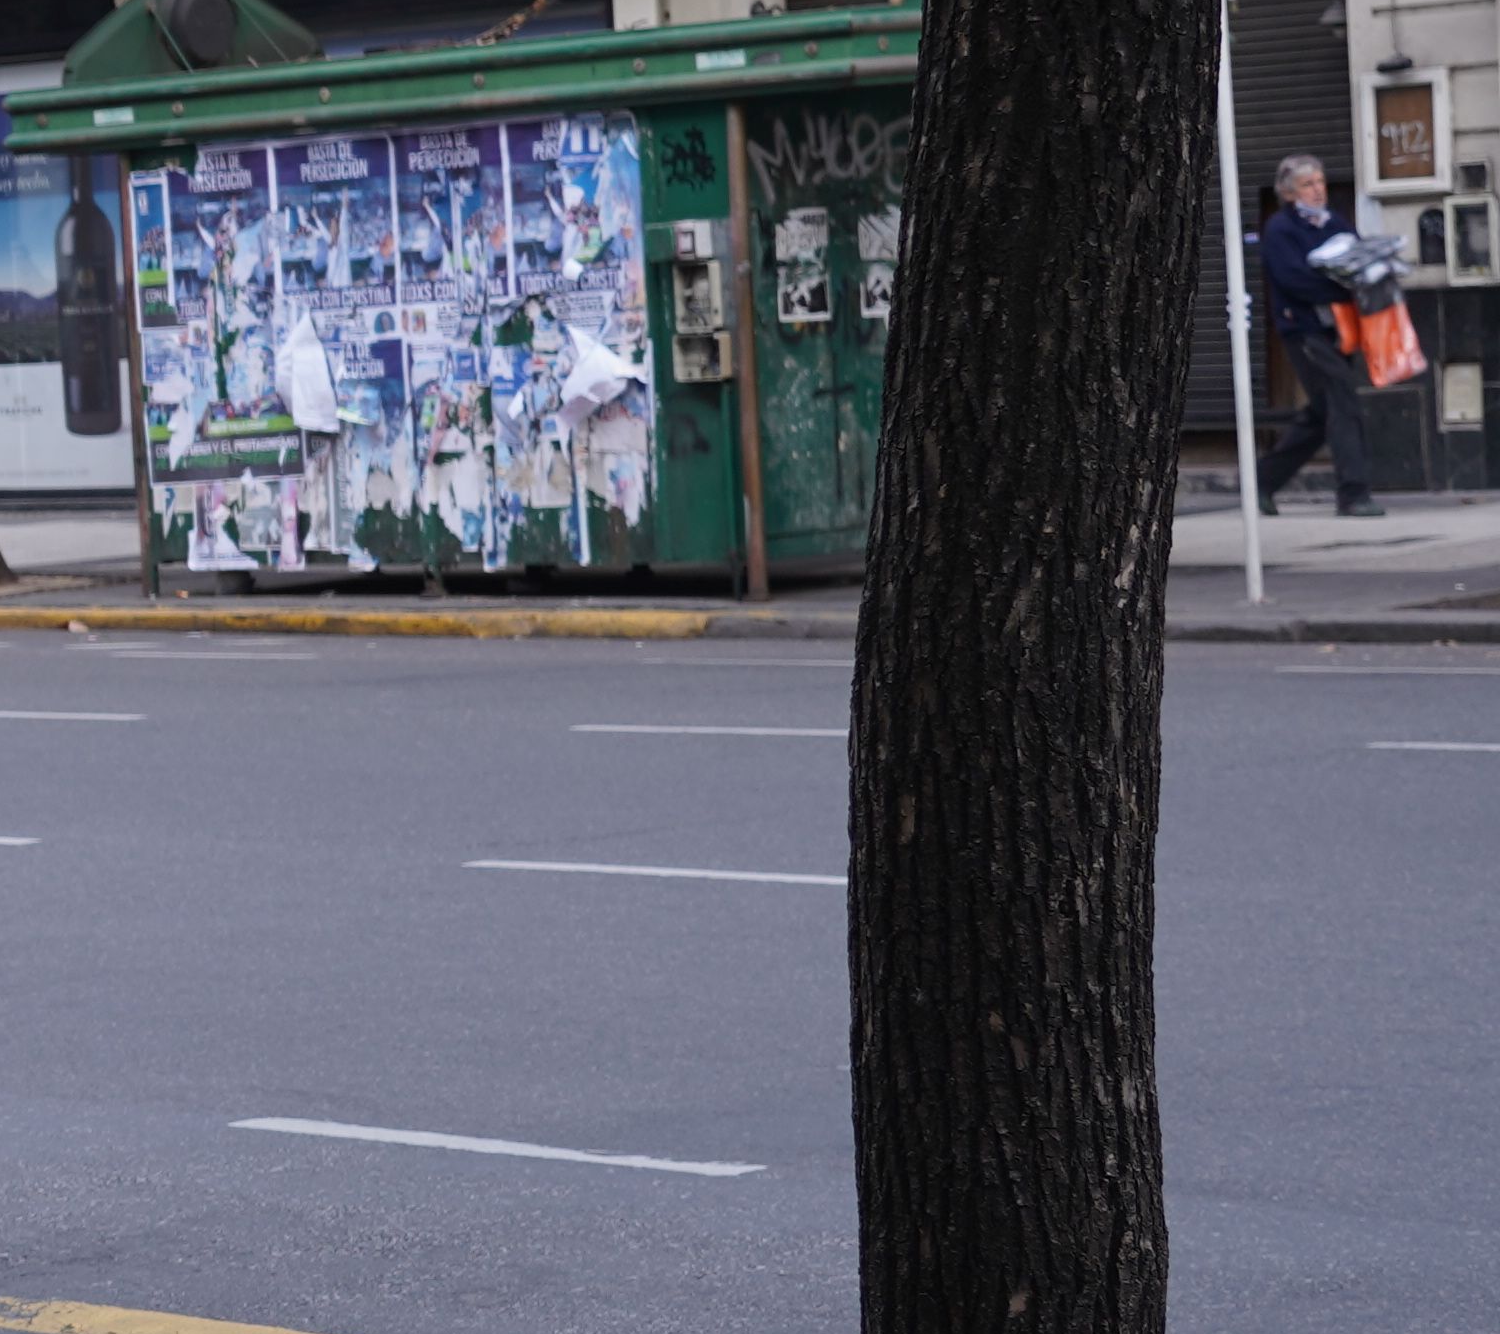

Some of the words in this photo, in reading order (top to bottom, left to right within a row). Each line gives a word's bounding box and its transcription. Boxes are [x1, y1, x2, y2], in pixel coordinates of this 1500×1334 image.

[307, 142, 337, 160] BASTA
[338, 140, 355, 157] DE
[419, 132, 452, 151] BASTA
[453, 131, 469, 149] DE
[321, 289, 339, 306] CON
[340, 284, 392, 304] CRISTINA
